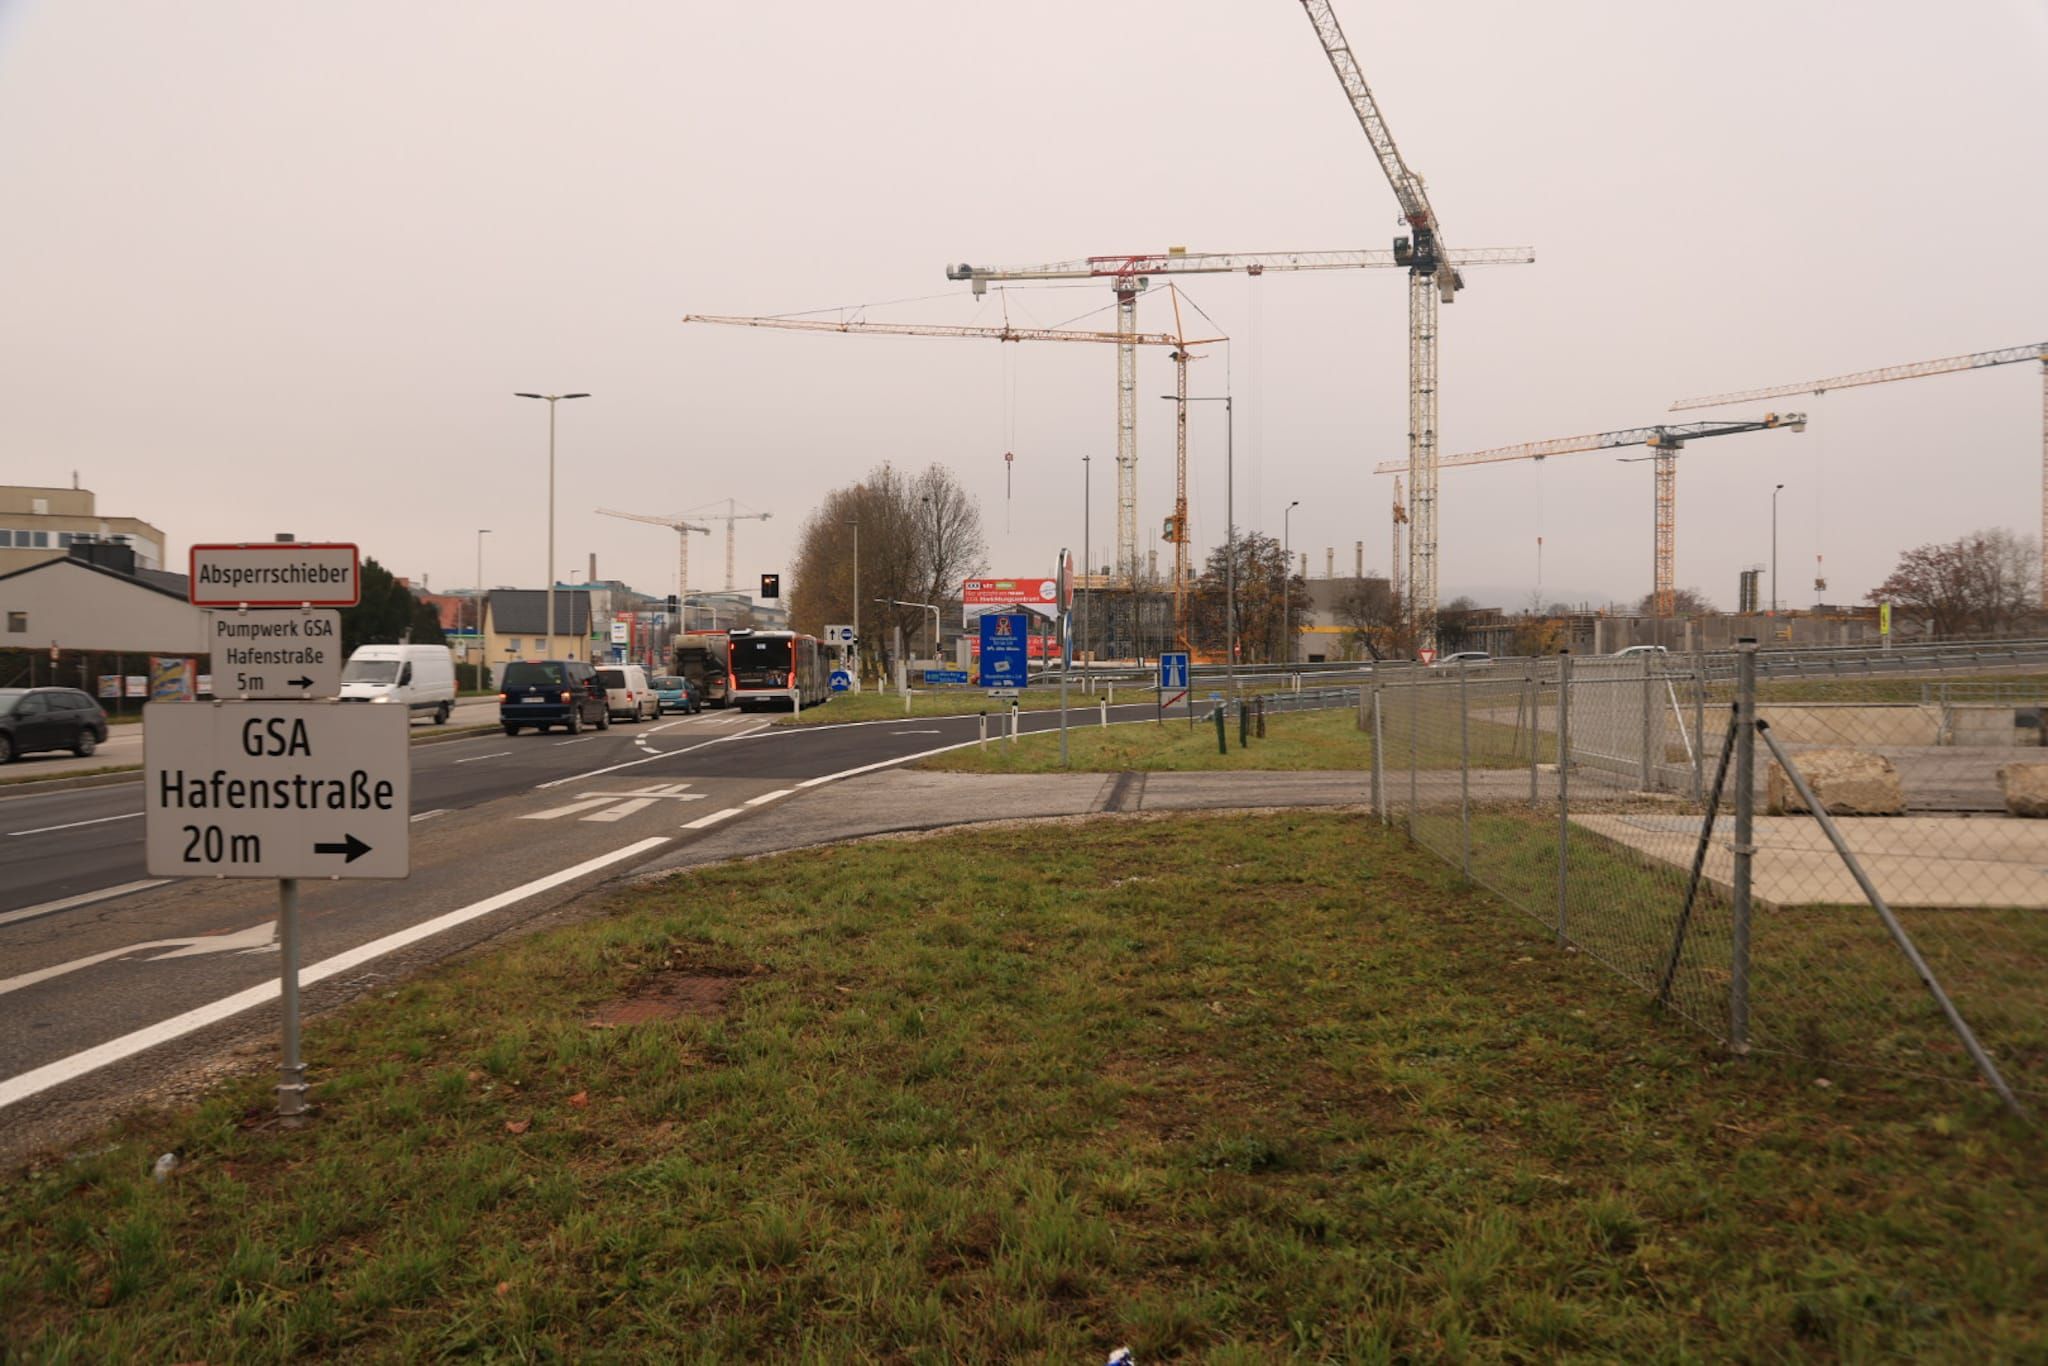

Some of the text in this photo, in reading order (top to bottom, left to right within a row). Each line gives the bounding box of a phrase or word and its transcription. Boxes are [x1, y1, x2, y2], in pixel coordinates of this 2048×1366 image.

[199, 562, 349, 588] Absperrschieber
[217, 619, 333, 640] Pumpwerk GSA
[227, 647, 324, 665] Hafenstraße
[242, 717, 312, 757] GSA
[160, 769, 394, 810] Hafenstraße
